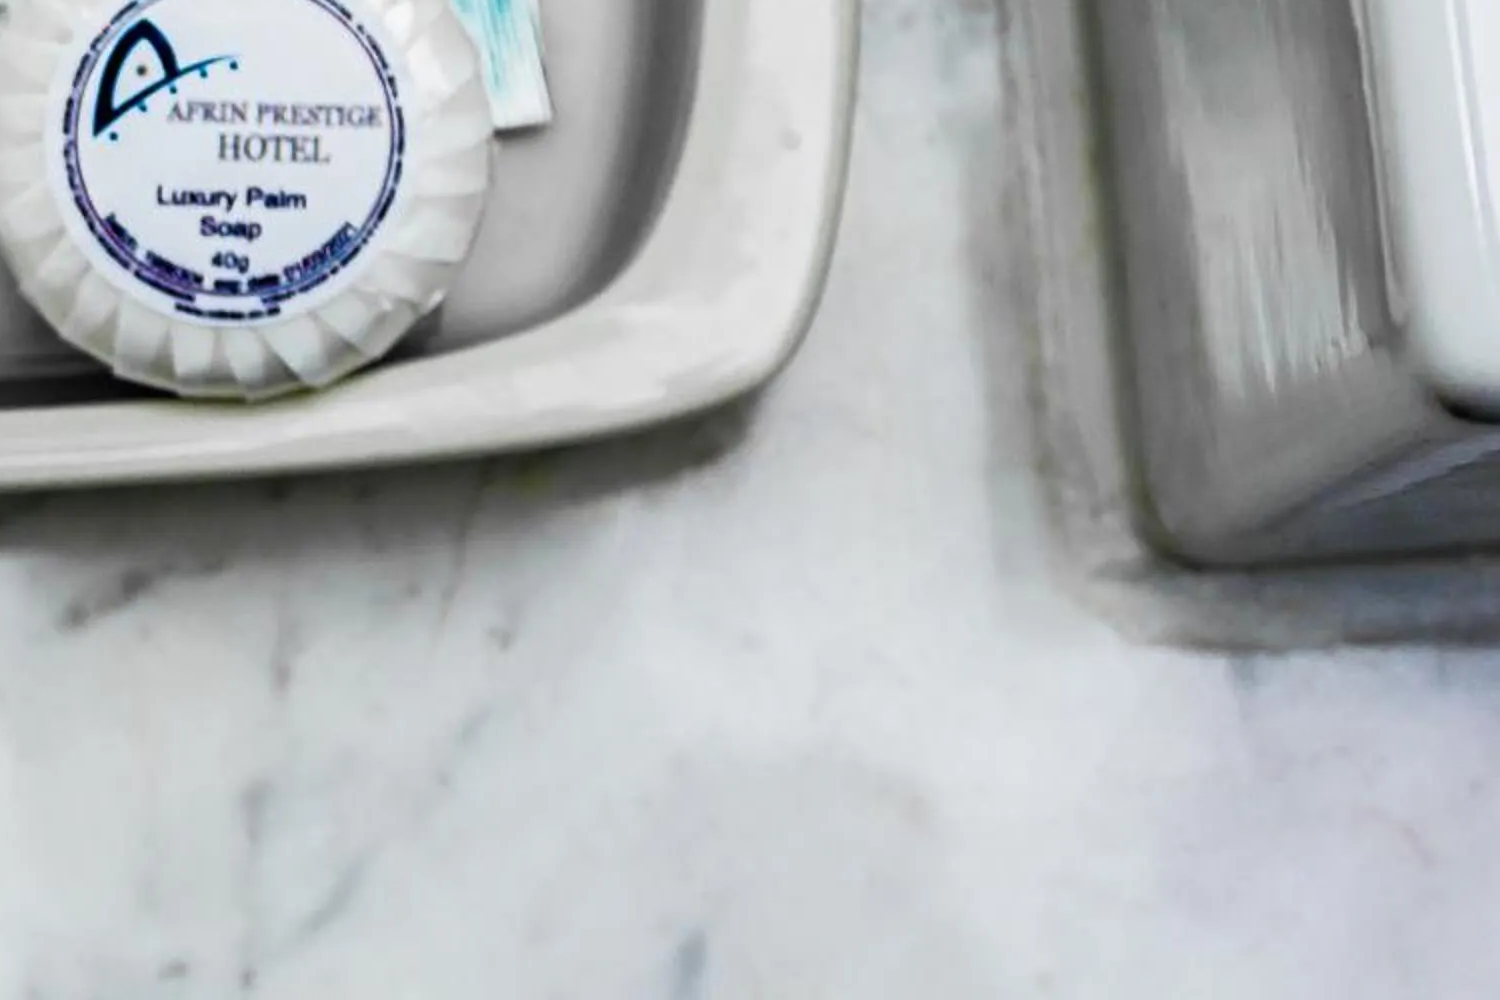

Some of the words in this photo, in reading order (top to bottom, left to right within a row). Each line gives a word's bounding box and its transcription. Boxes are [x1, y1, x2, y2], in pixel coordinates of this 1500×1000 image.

[167, 101, 249, 124] AFRIN
[257, 102, 384, 128] PRESTIGE
[217, 133, 331, 164] HOTEL
[157, 186, 238, 210] Luxury
[246, 187, 308, 210] Palm
[199, 216, 263, 240] Soap
[211, 252, 250, 273] 40g
